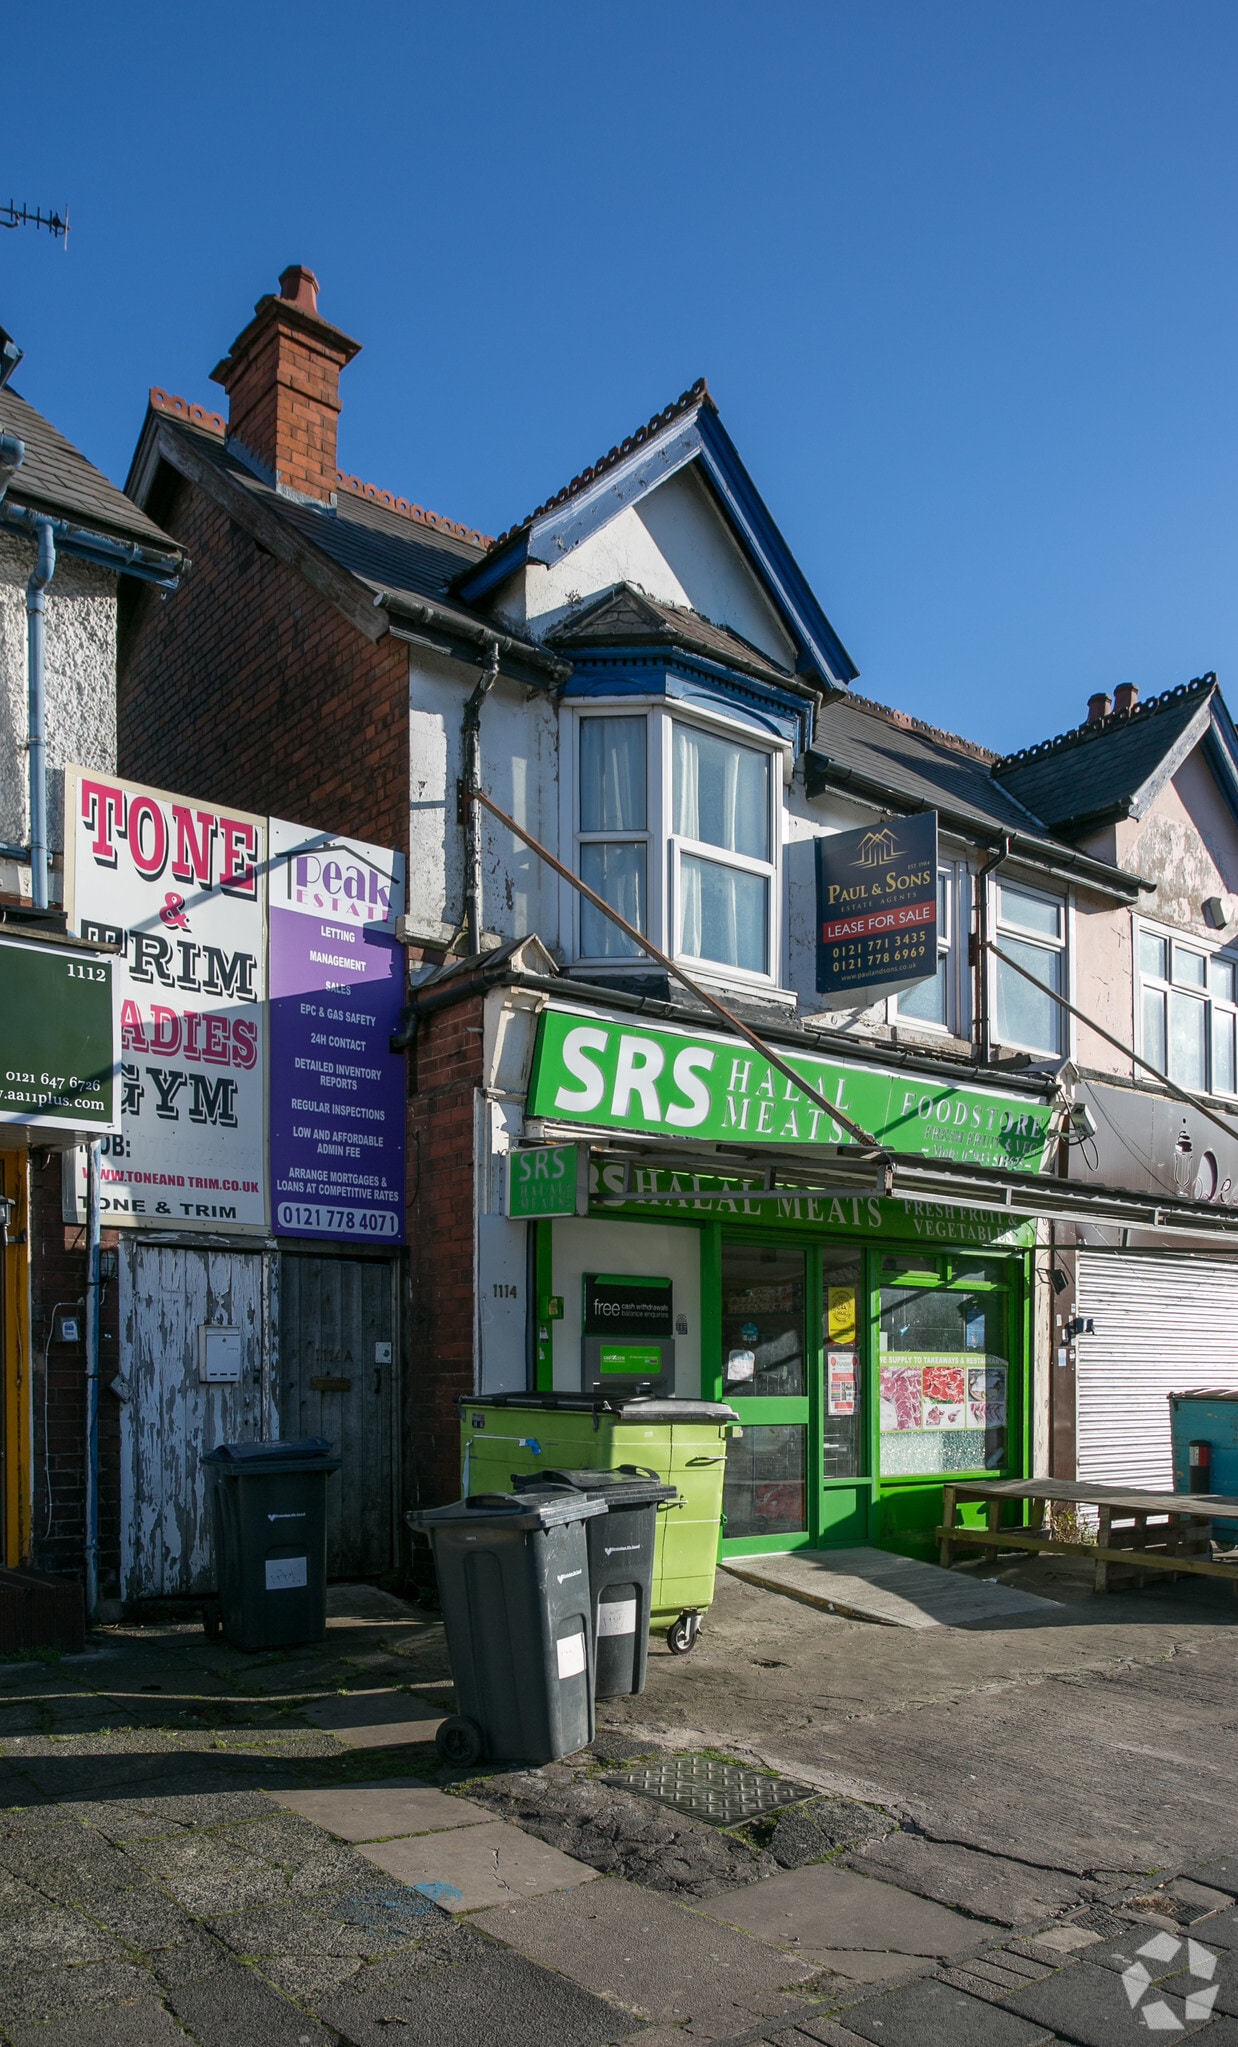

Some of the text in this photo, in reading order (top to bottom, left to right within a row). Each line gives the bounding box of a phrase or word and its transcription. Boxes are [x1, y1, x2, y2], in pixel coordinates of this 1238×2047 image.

[82, 779, 257, 902] TONE
[296, 856, 393, 908] Peak
[871, 883, 883, 896] &
[160, 892, 192, 933] &
[296, 889, 393, 924] ESTATE
[841, 892, 917, 912] ESTATE AGENTS
[321, 925, 355, 942] LETTING
[828, 907, 930, 938] LEASE FOR SALE
[833, 931, 926, 958] 0121 771 3435
[309, 951, 366, 971] MANAGEMENT
[833, 946, 925, 972] 0121 778 6969
[67, 963, 106, 982] 1112
[841, 962, 916, 981] www.paulandsons.co.uk
[325, 981, 351, 995] SALES
[300, 1003, 376, 1027] EPC & GAS SAFETY
[121, 999, 257, 1070] ADIES
[311, 1033, 366, 1051] 24H CONTACT
[295, 1057, 382, 1080] DETAILED INVENTORY
[554, 1026, 717, 1128] SRS
[5, 1071, 100, 1092] 0121 647 6726
[320, 1075, 357, 1090] REPORTS
[726, 1058, 852, 1111] HALAL
[291, 1098, 385, 1121] REGULAR INSPECTIONS
[721, 1095, 846, 1144] MEATS
[900, 1092, 1044, 1139] FOODSTORE
[293, 1126, 383, 1147] LOW AND AFFORDABLE
[924, 1125, 1038, 1155] FRESH FRUIT & VEG
[317, 1143, 360, 1157] ADMIN FEE
[519, 1148, 565, 1182] SRS
[188, 1176, 259, 1193] TRIM.CO.UK
[289, 1167, 387, 1187] ARRANGE MORTGAGES &
[277, 1180, 399, 1201] LOANS AT COMPETITIVE RATES
[634, 1169, 761, 1216] HALAL
[776, 1196, 882, 1228] MEATS
[155, 1201, 171, 1214] &
[180, 1203, 237, 1219] TRIM
[283, 1206, 395, 1232] 0121 778 4071
[904, 1200, 1018, 1227] FRESH FRUIT &
[913, 1218, 1014, 1243] VEGETABLES
[493, 1283, 517, 1299] 1114
[593, 1298, 621, 1317] free
[636, 1303, 669, 1311] withdrawals
[621, 1309, 669, 1319] balance enquiries
[889, 1356, 912, 1364] SUPPLY
[914, 1356, 922, 1364] TO
[923, 1356, 959, 1364] TAKEAWAYS
